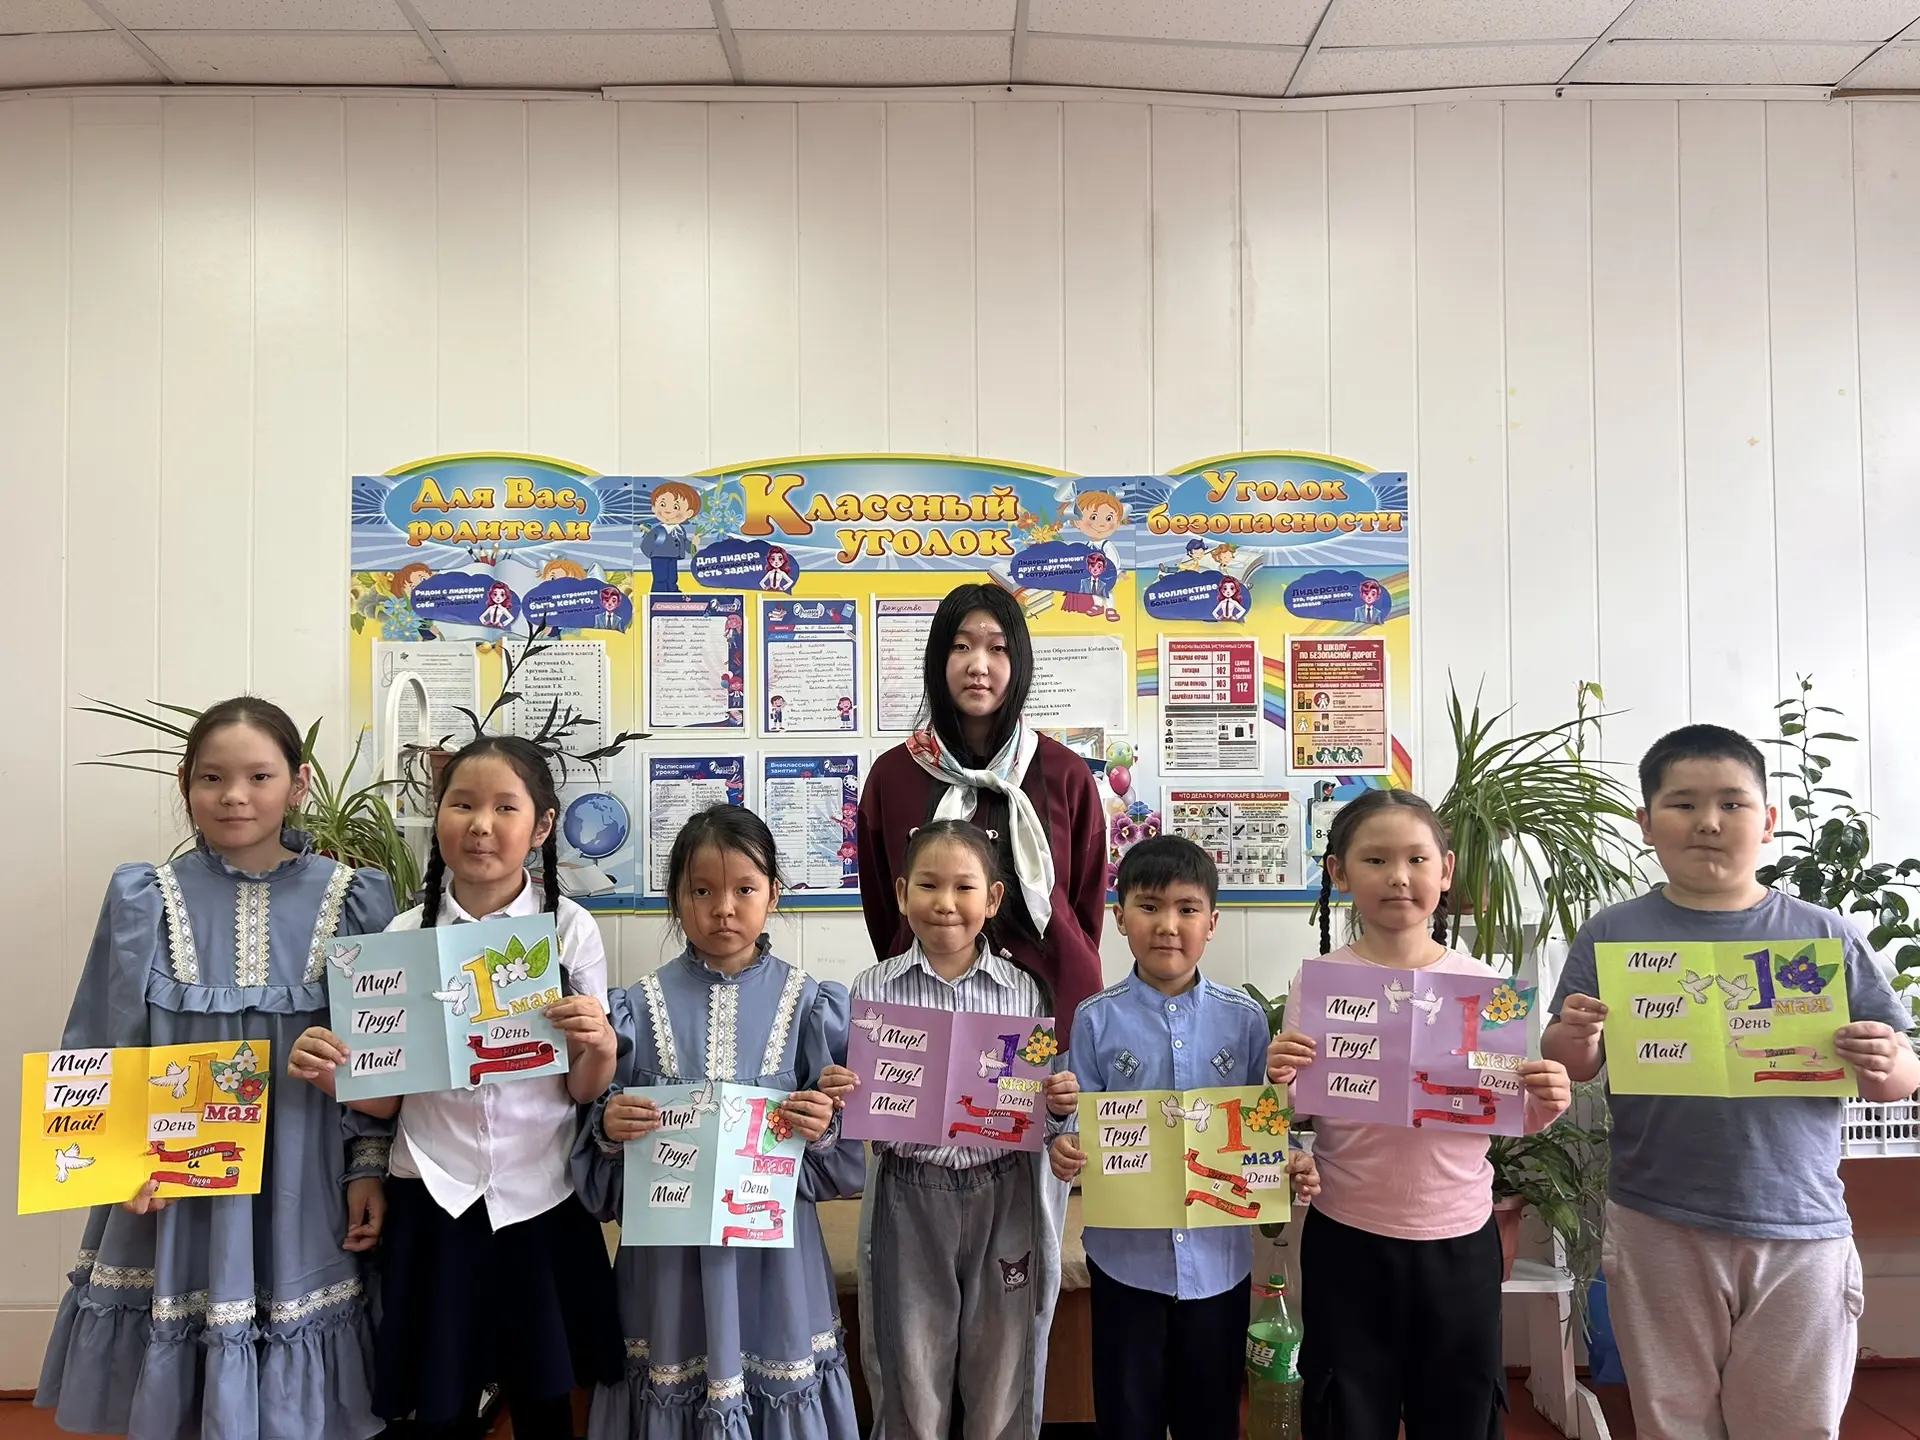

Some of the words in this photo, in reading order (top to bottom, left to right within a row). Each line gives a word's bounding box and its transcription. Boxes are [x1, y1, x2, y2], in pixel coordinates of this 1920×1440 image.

[411, 477, 495, 513] Для
[504, 477, 587, 514] Вас,
[1202, 471, 1347, 502] Уголок
[739, 473, 1019, 536] Классный
[1147, 504, 1402, 535] безопасности
[407, 519, 591, 547] родители
[837, 529, 1014, 563] уголок
[696, 557, 717, 566] Для
[720, 551, 760, 562] лидера
[697, 570, 722, 578] есть
[724, 564, 763, 575] задачи
[1025, 569, 1084, 578] сотрудничают
[1149, 592, 1156, 600] В
[1158, 584, 1218, 599] коллективе
[1292, 584, 1350, 596] Лидерство
[529, 602, 555, 610] быть
[557, 598, 593, 607] кем-то,
[882, 603, 922, 612] Дежурство
[1150, 598, 1187, 607] большая
[1189, 593, 1210, 601] сила
[1310, 650, 1351, 659] БЕЗОПАСНОЙ
[1352, 651, 1376, 659] ДОРОГЕ
[1236, 683, 1248, 692] 112
[1627, 952, 1677, 973] Мир!
[355, 971, 403, 995] Мир!
[1744, 949, 1775, 1010] 1
[463, 956, 509, 1024] 1
[510, 987, 561, 1016] мая
[1327, 998, 1375, 1022] Мир!
[1635, 997, 1683, 1018] Труд!
[1775, 998, 1829, 1015] мая
[357, 1009, 405, 1034] Труд!
[1450, 994, 1480, 1056] 1
[1729, 1017, 1771, 1030] День
[490, 1026, 530, 1040] День
[882, 1028, 926, 1050] Мир!
[1331, 1037, 1376, 1059] Труд!
[1639, 1043, 1687, 1059] Май!
[51, 1052, 108, 1076] Мир!
[354, 1048, 402, 1071] Май!
[988, 1034, 1020, 1083] 1
[1472, 1052, 1527, 1070] мая
[181, 1052, 218, 1113] 1
[879, 1062, 922, 1084] Труд!
[999, 1077, 1042, 1093] мая
[1329, 1076, 1376, 1095] Май!
[1481, 1075, 1520, 1091] День
[53, 1082, 108, 1107] Труд!
[1000, 1093, 1034, 1107] День
[205, 1105, 260, 1122] мая
[871, 1096, 916, 1113] Май!
[1099, 1100, 1144, 1119] Мир!
[47, 1112, 104, 1134] Май!
[153, 1119, 196, 1133] День
[659, 1110, 696, 1130] Мир!
[735, 1098, 768, 1158] 1
[1217, 1098, 1252, 1154] 1
[1104, 1126, 1147, 1147] Труд!
[187, 1160, 200, 1169] и
[659, 1142, 698, 1168] Труд!
[1105, 1153, 1149, 1170] Май!
[1241, 1150, 1286, 1166] мая
[753, 1158, 795, 1175] мая
[187, 1175, 211, 1186] Труда
[741, 1180, 769, 1194] День
[1213, 1182, 1220, 1190] и
[1245, 1172, 1280, 1184] День
[651, 1185, 691, 1203] Май!
